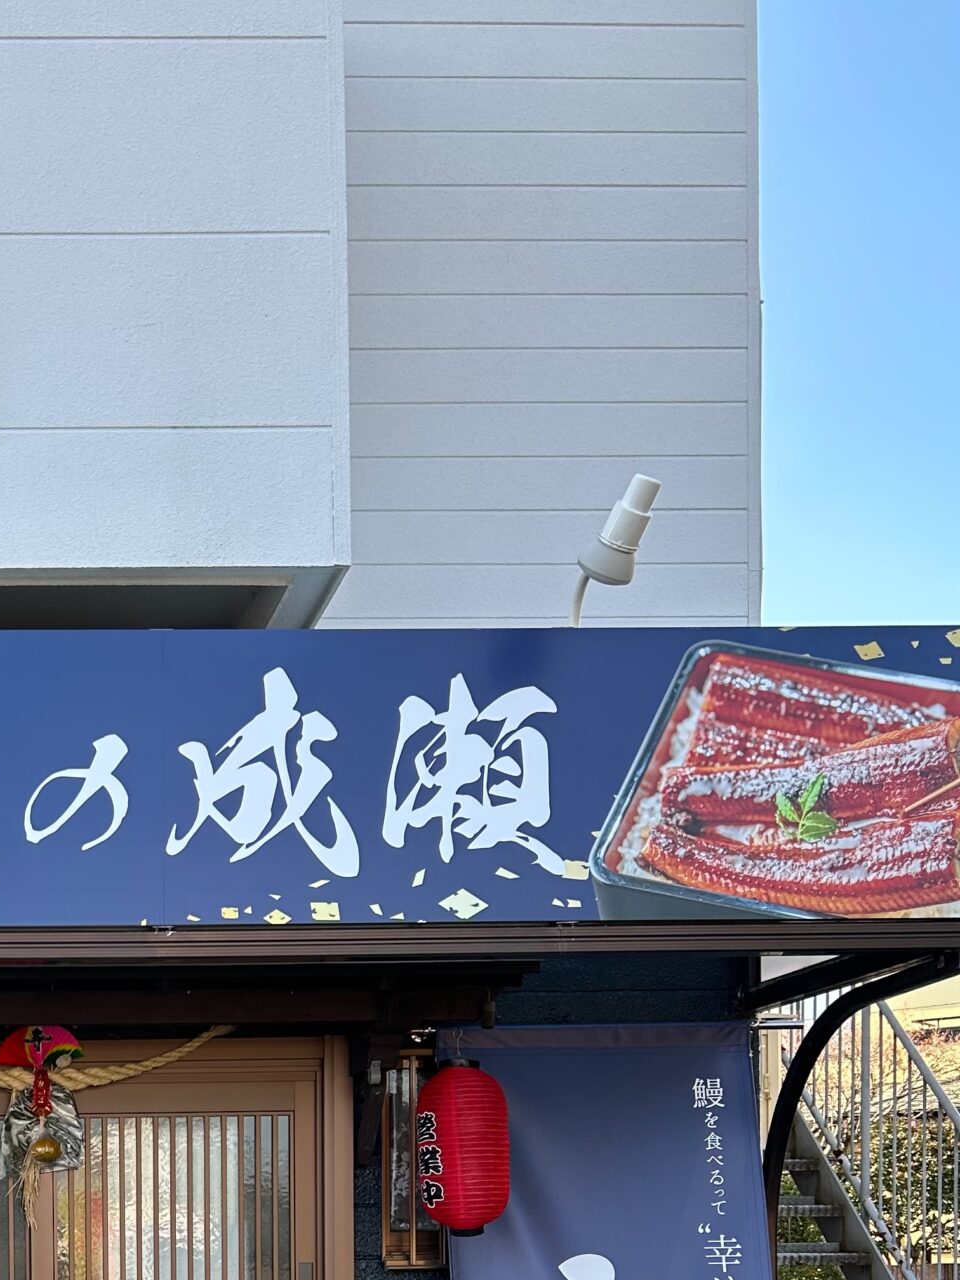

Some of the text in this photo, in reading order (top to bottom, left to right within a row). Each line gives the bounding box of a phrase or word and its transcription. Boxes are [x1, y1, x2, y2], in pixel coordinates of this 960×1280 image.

[692, 1078, 727, 1215] 鰻を食べるって
